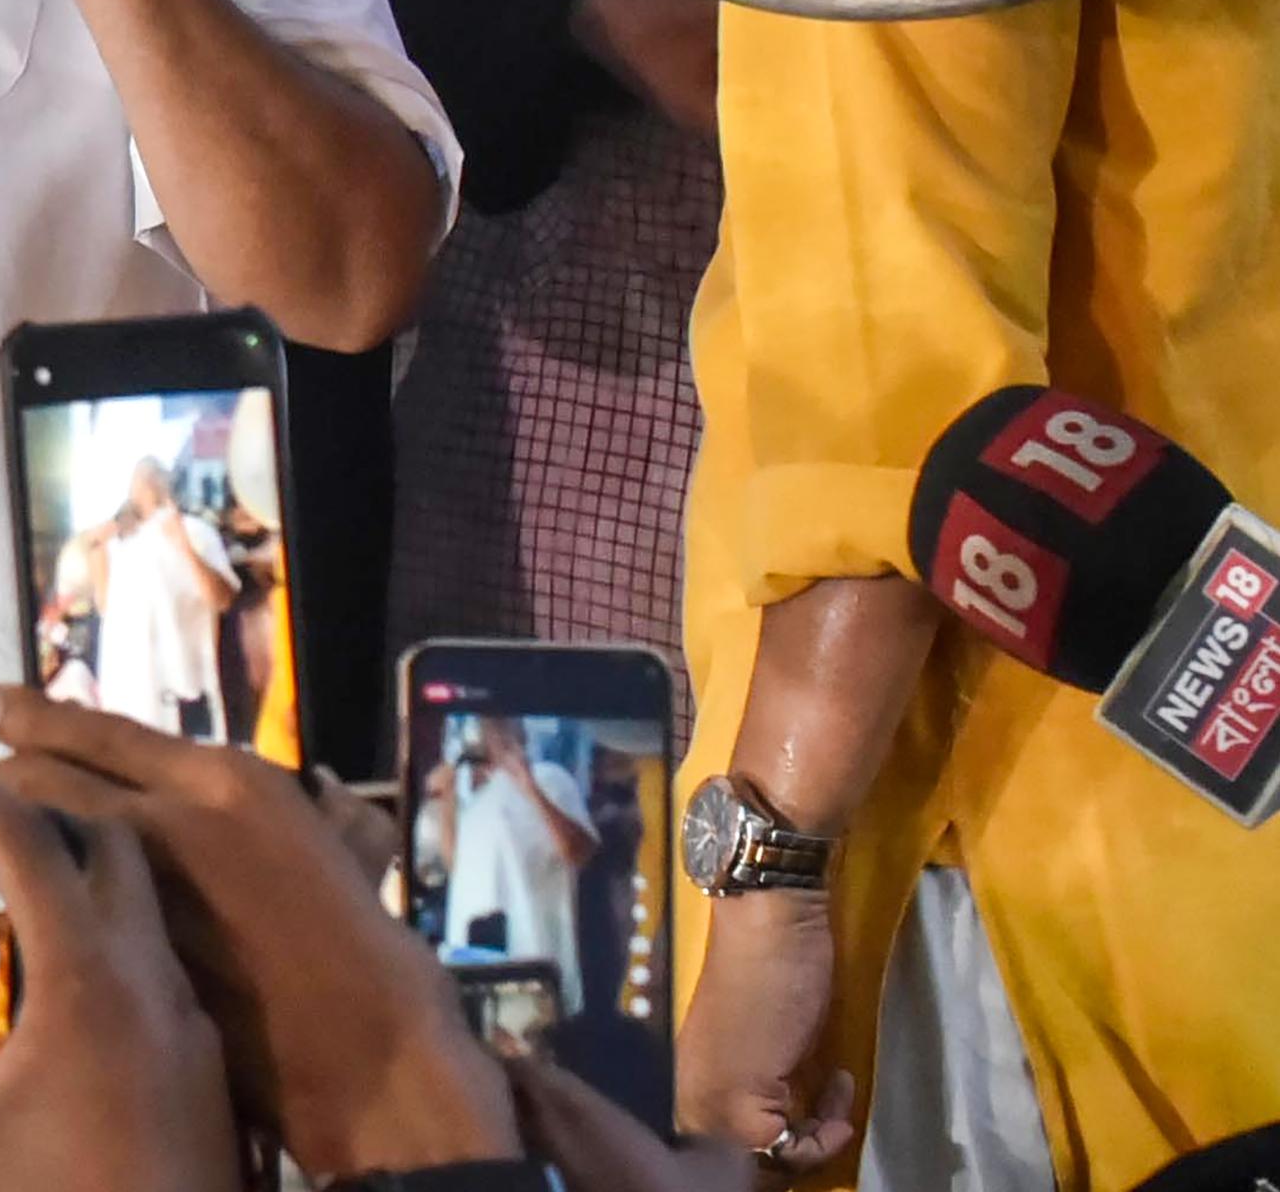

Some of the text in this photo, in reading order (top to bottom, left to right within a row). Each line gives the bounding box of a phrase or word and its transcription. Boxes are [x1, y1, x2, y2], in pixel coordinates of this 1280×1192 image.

[1010, 410, 1137, 493] 18
[952, 534, 1038, 640] 18
[1156, 564, 1263, 734] NEWS 18
